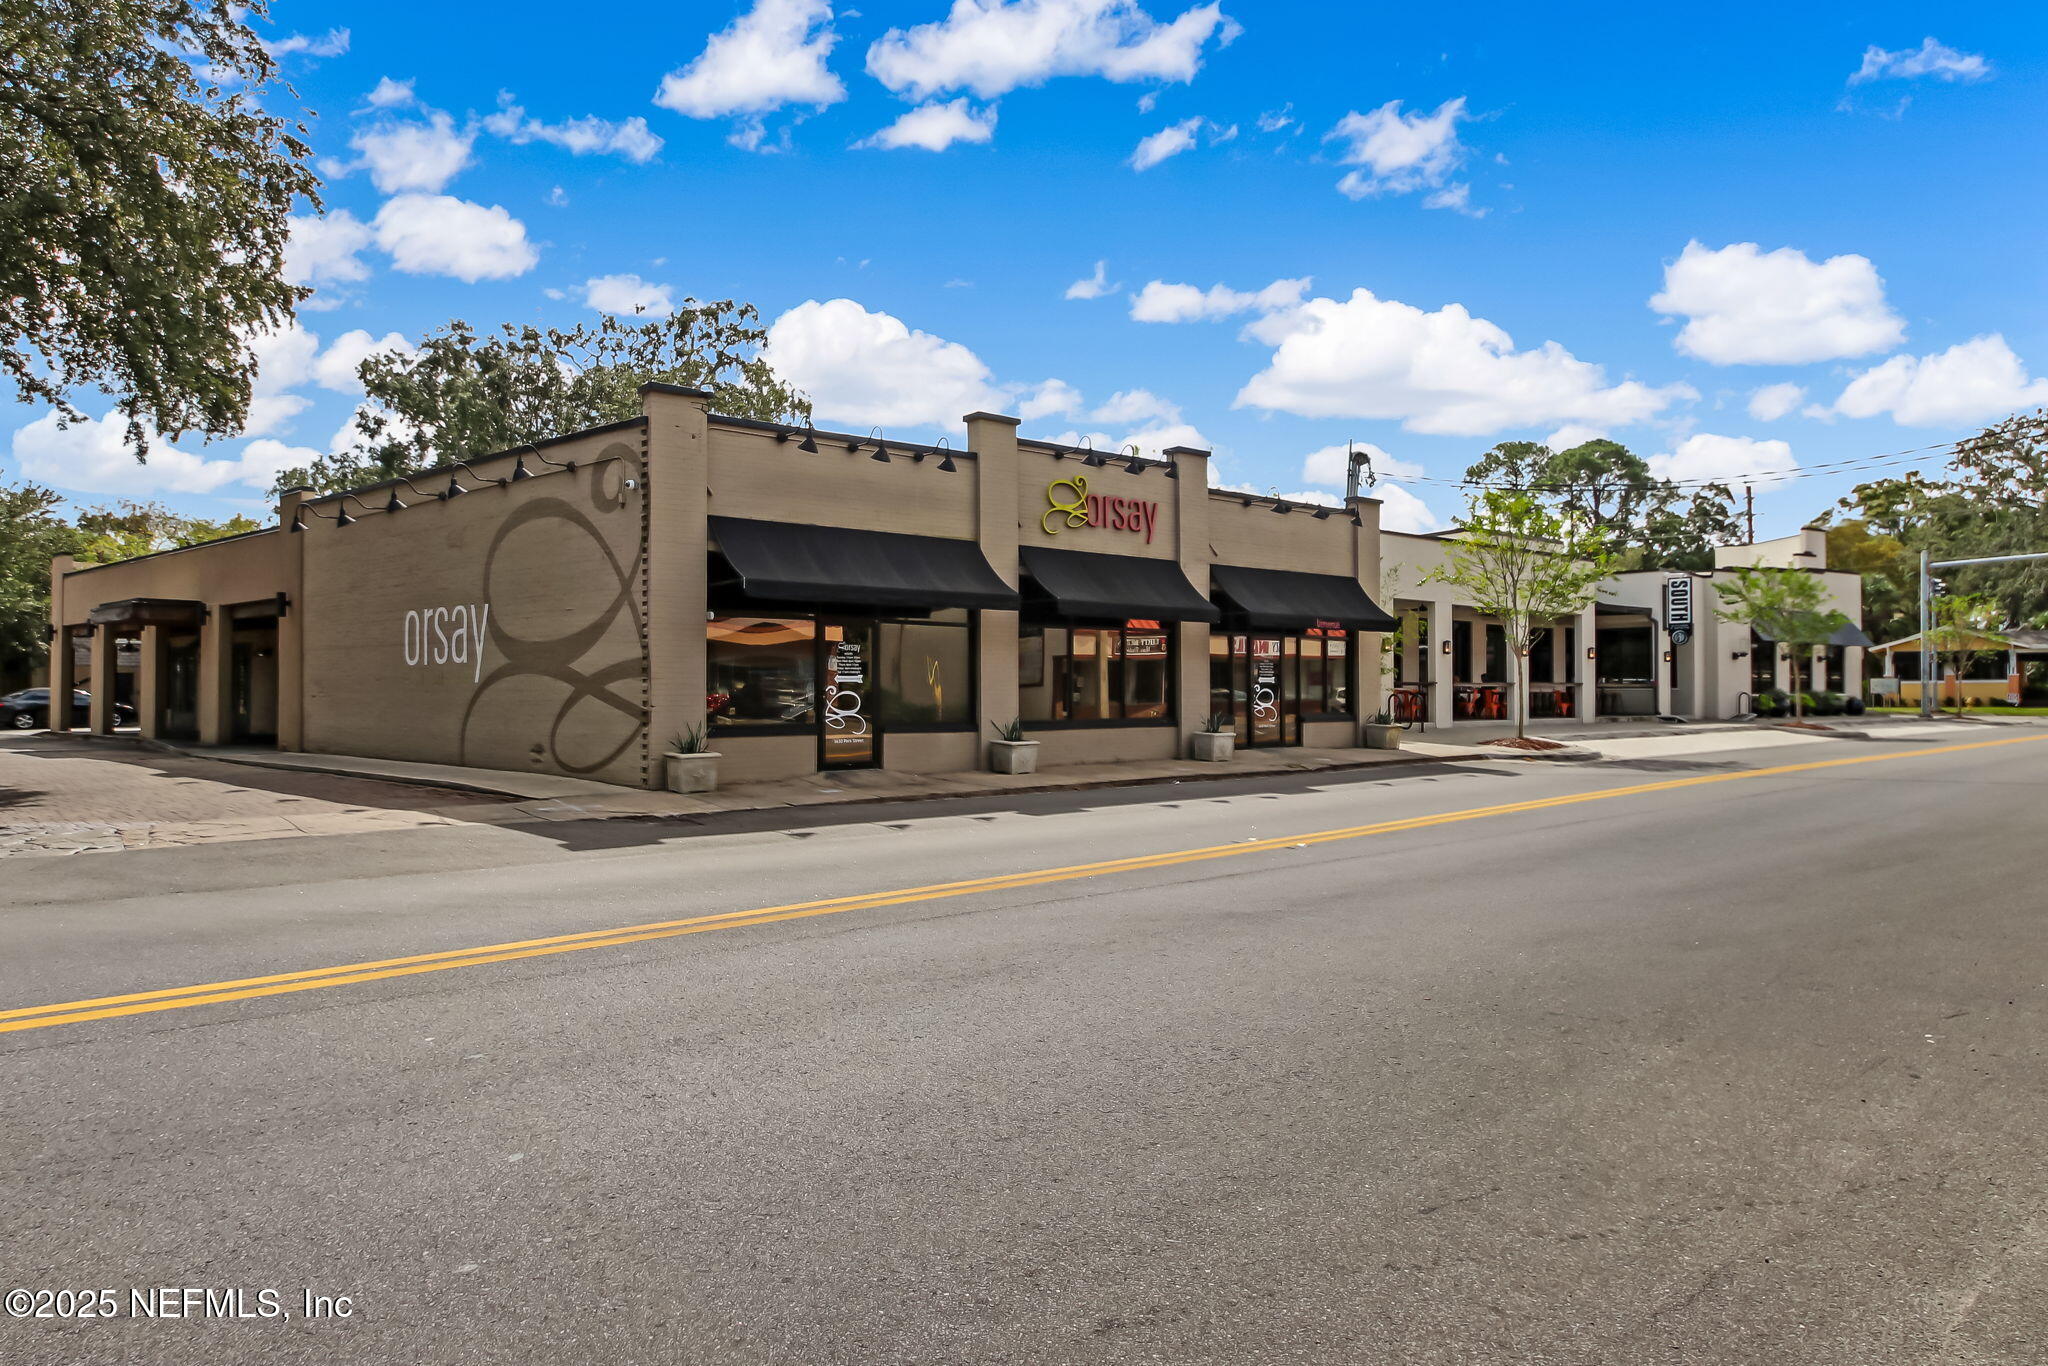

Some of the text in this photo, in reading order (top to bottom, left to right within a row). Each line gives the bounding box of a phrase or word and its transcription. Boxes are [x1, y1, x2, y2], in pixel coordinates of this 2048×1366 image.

[1086, 494, 1158, 544] orsay
[1670, 580, 1688, 621] SOUTH
[404, 603, 489, 683] orsay
[844, 644, 860, 653] orsay
